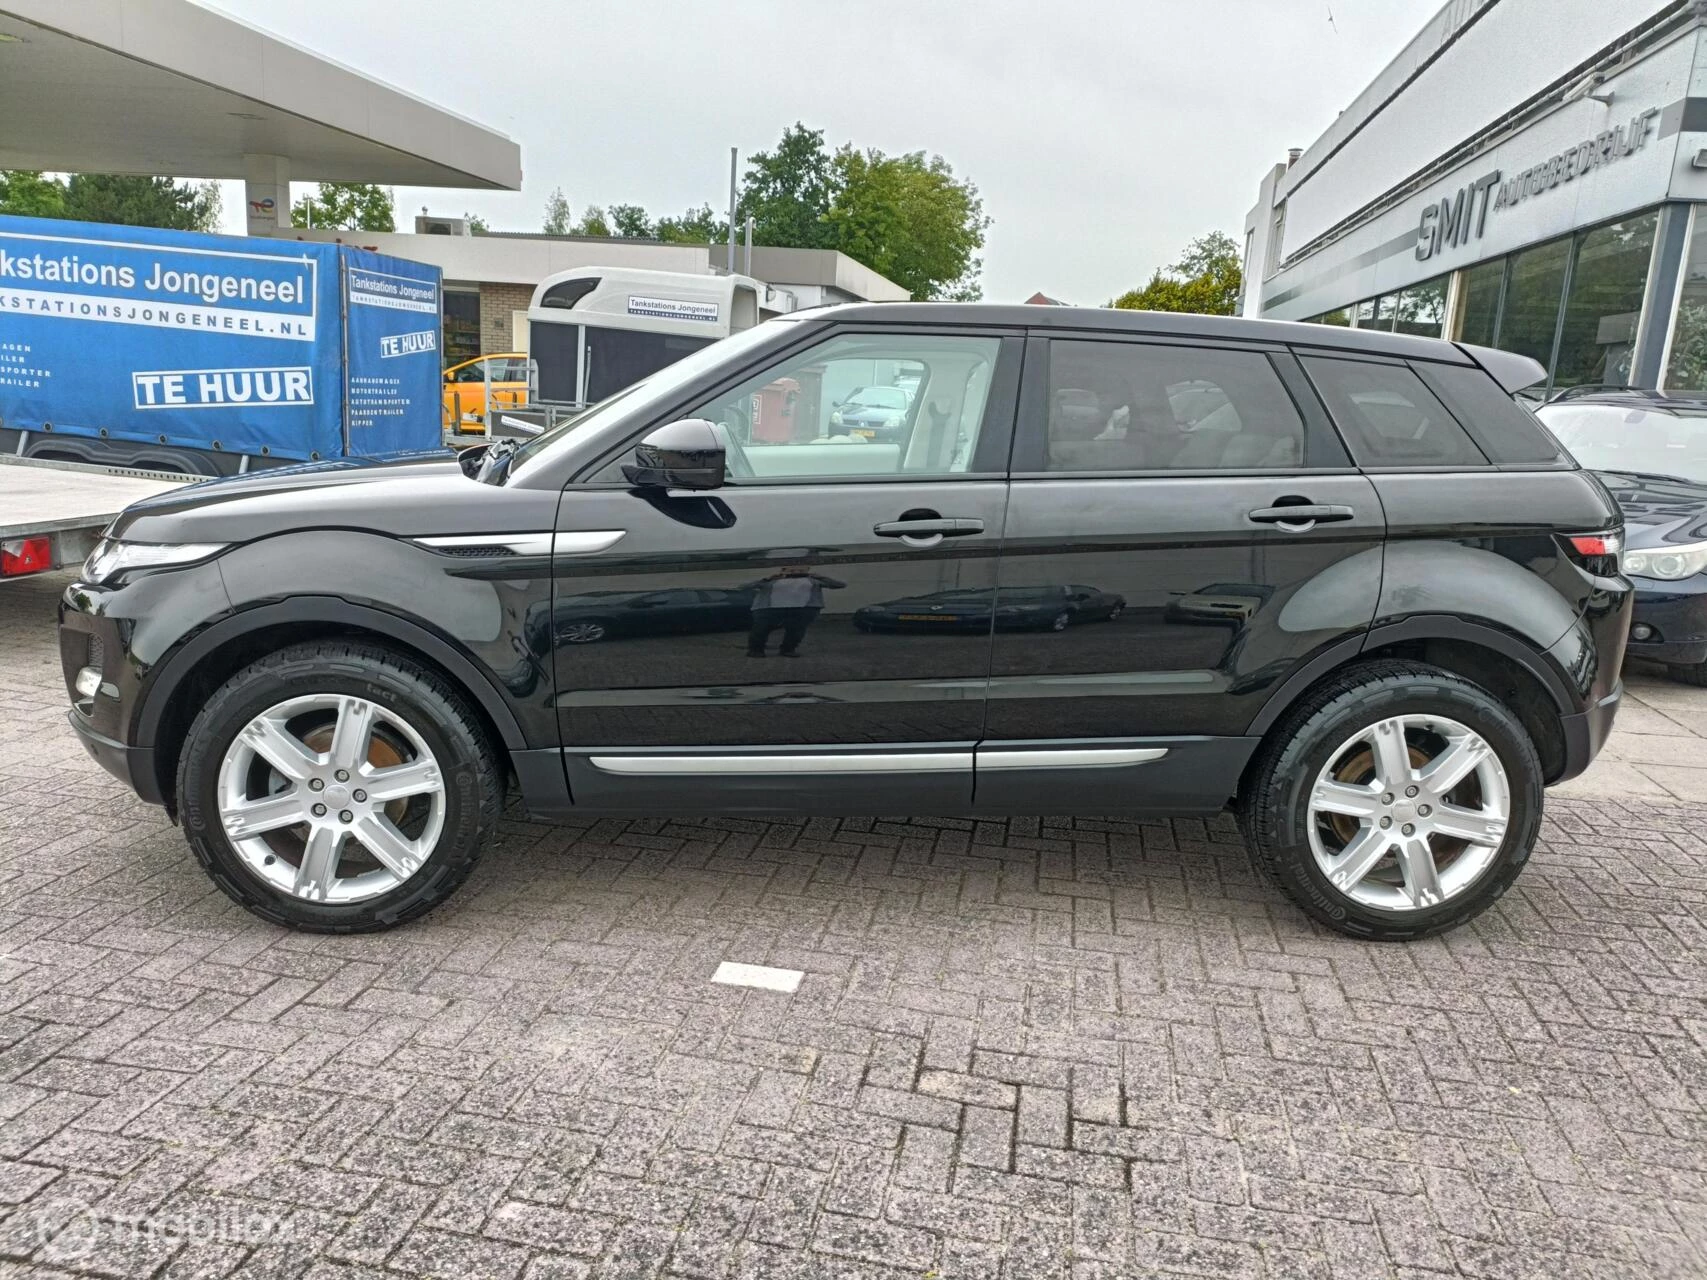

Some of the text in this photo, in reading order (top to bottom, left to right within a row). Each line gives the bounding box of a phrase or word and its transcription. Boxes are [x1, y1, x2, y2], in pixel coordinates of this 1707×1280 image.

[1415, 169, 1500, 261] SMIT
[144, 263, 303, 303] Jongeneel
[351, 275, 434, 300] Tankstations Jongeneel
[631, 299, 716, 314] Tankstations Jongeneel
[382, 332, 434, 355] TE HUUR
[136, 371, 311, 404] TE HUUR
